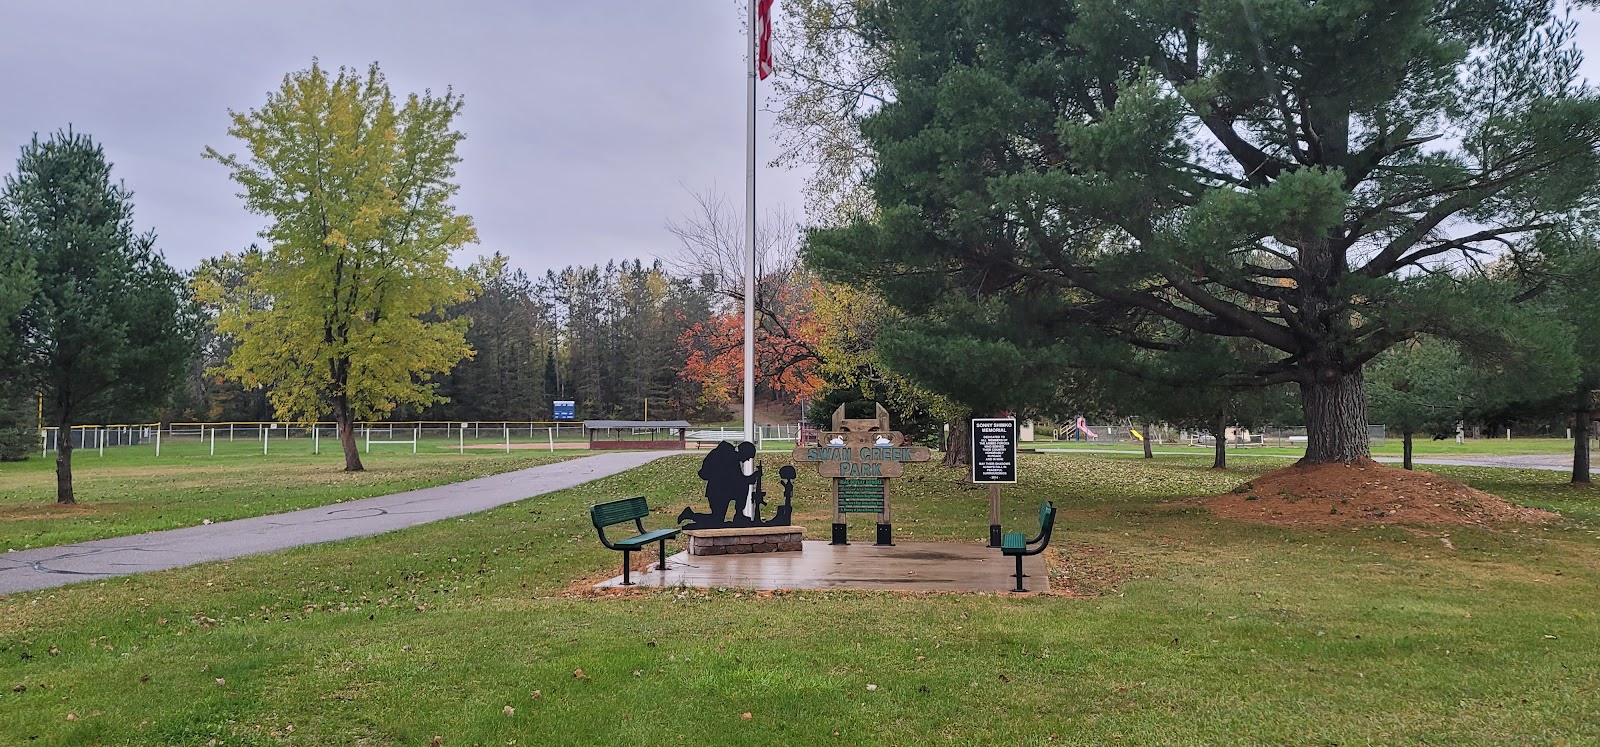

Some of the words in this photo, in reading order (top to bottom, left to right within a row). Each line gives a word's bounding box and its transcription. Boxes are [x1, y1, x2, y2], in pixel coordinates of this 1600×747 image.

[808, 447, 852, 461] SWAN
[860, 446, 912, 462] CREEK
[840, 462, 882, 476] PARK
